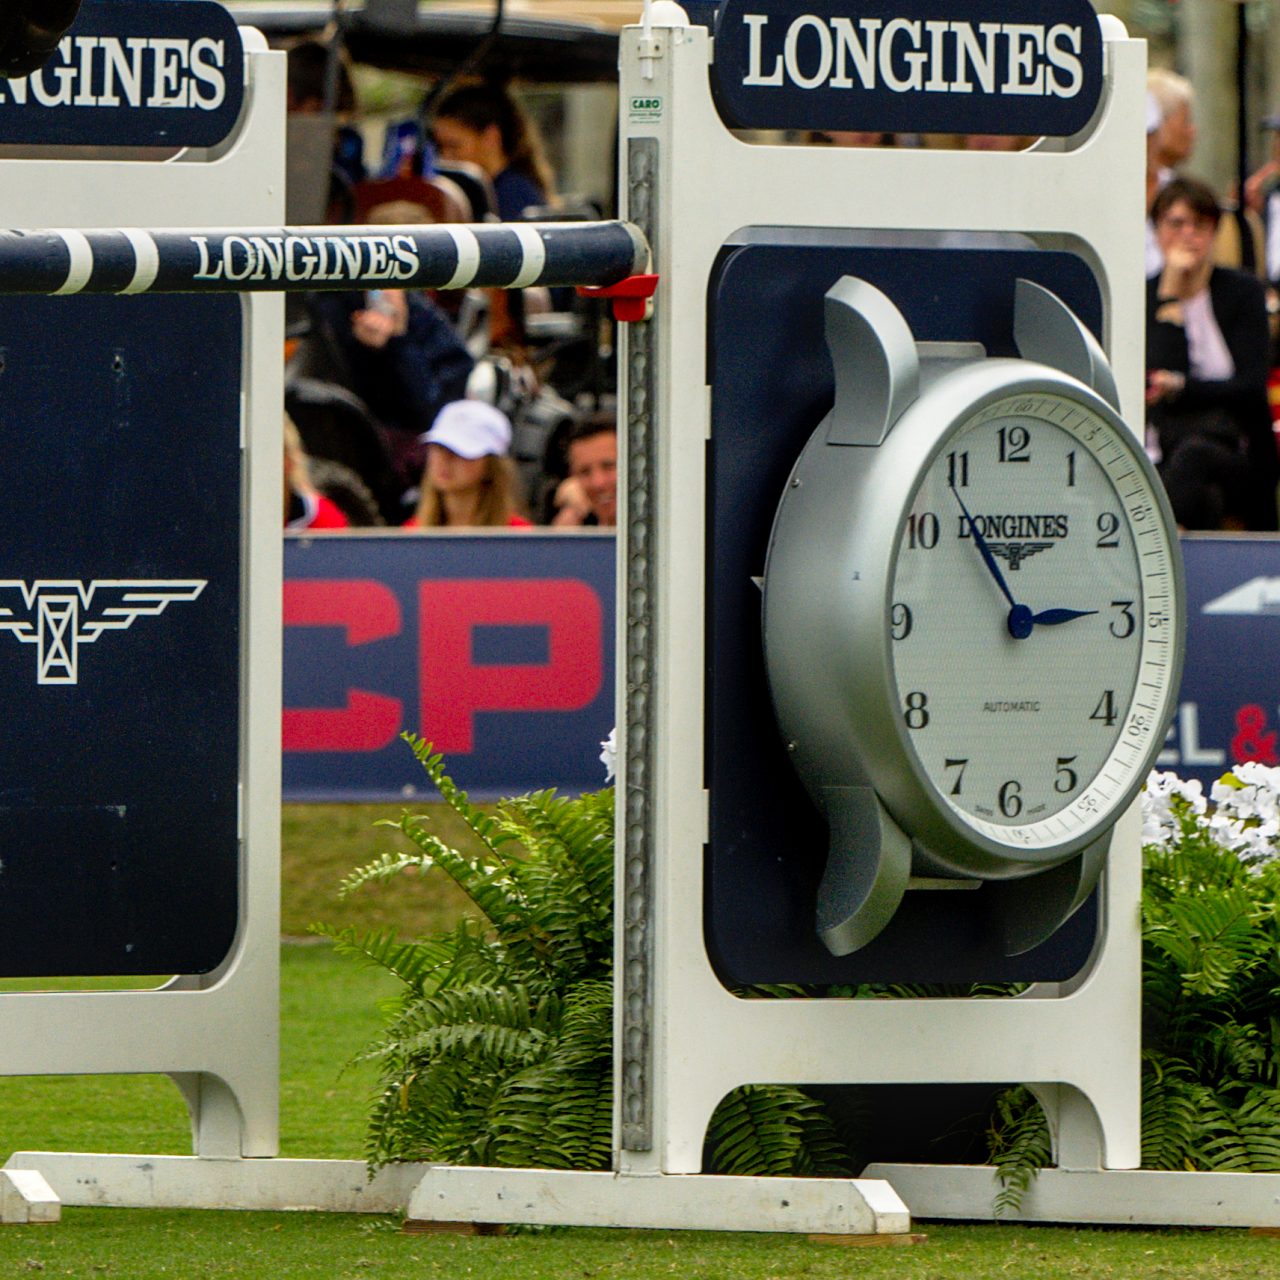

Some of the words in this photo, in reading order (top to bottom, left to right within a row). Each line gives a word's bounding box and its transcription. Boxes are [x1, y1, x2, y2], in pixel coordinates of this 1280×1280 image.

[742, 13, 1083, 100] LONGINES
[631, 99, 660, 110] CARO
[189, 233, 420, 282] LONGINES
[995, 426, 1031, 462] 12
[946, 450, 969, 488] 11
[1066, 450, 1076, 487] 1
[906, 512, 940, 550] 10
[958, 515, 1068, 539] LONGINES
[1096, 512, 1121, 549] 2
[891, 602, 913, 641] 9
[1108, 601, 1136, 639] 3
[282, 577, 603, 755] CP
[903, 691, 930, 730] 8
[982, 701, 1041, 713] AUTOMATIC
[1088, 689, 1118, 727] 4
[944, 758, 969, 795] 7
[1054, 755, 1078, 793] 5
[998, 780, 1023, 818] 6
